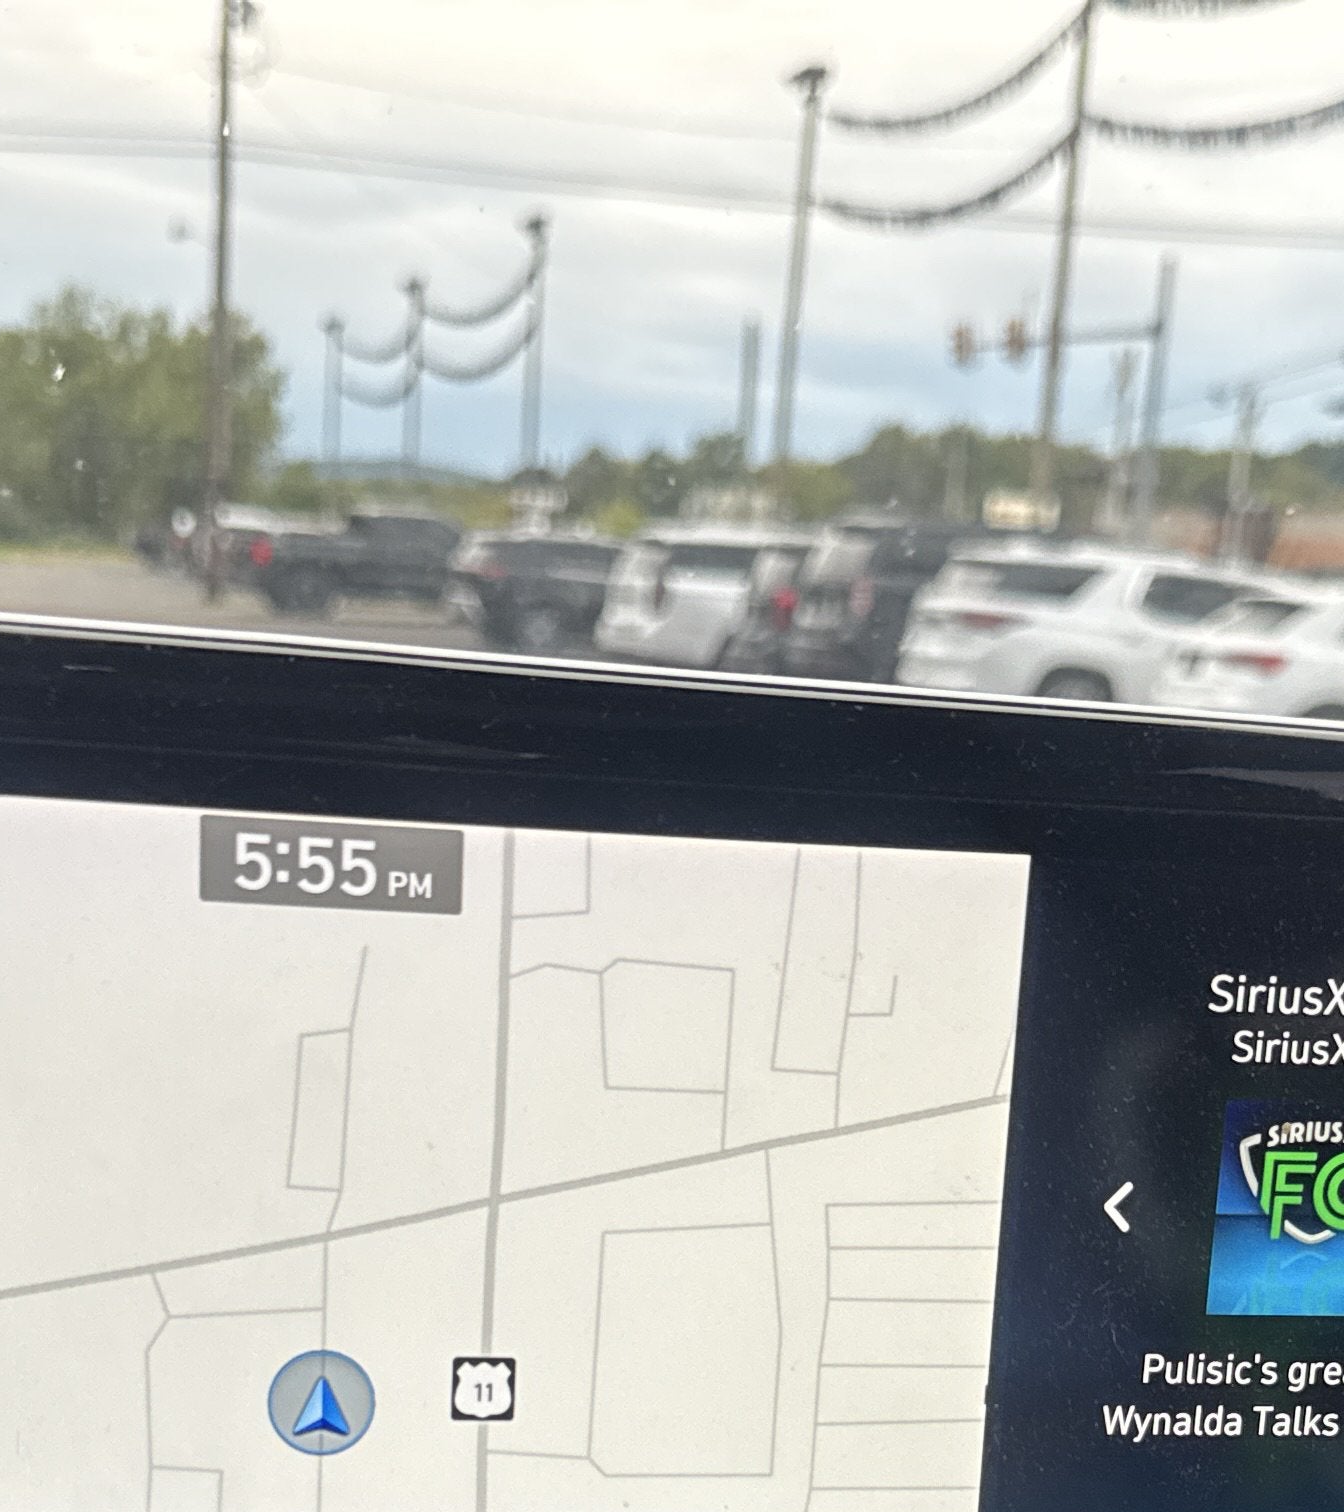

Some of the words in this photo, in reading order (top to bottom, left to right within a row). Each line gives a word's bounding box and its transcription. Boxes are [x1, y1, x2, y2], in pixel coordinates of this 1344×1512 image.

[235, 832, 377, 896] 5:55
[388, 871, 432, 899] PM
[1143, 1354, 1277, 1384] Pulisic's
[474, 1382, 493, 1403] 11
[1103, 1405, 1242, 1442] Wynalda
[1253, 1406, 1339, 1436] Talks
